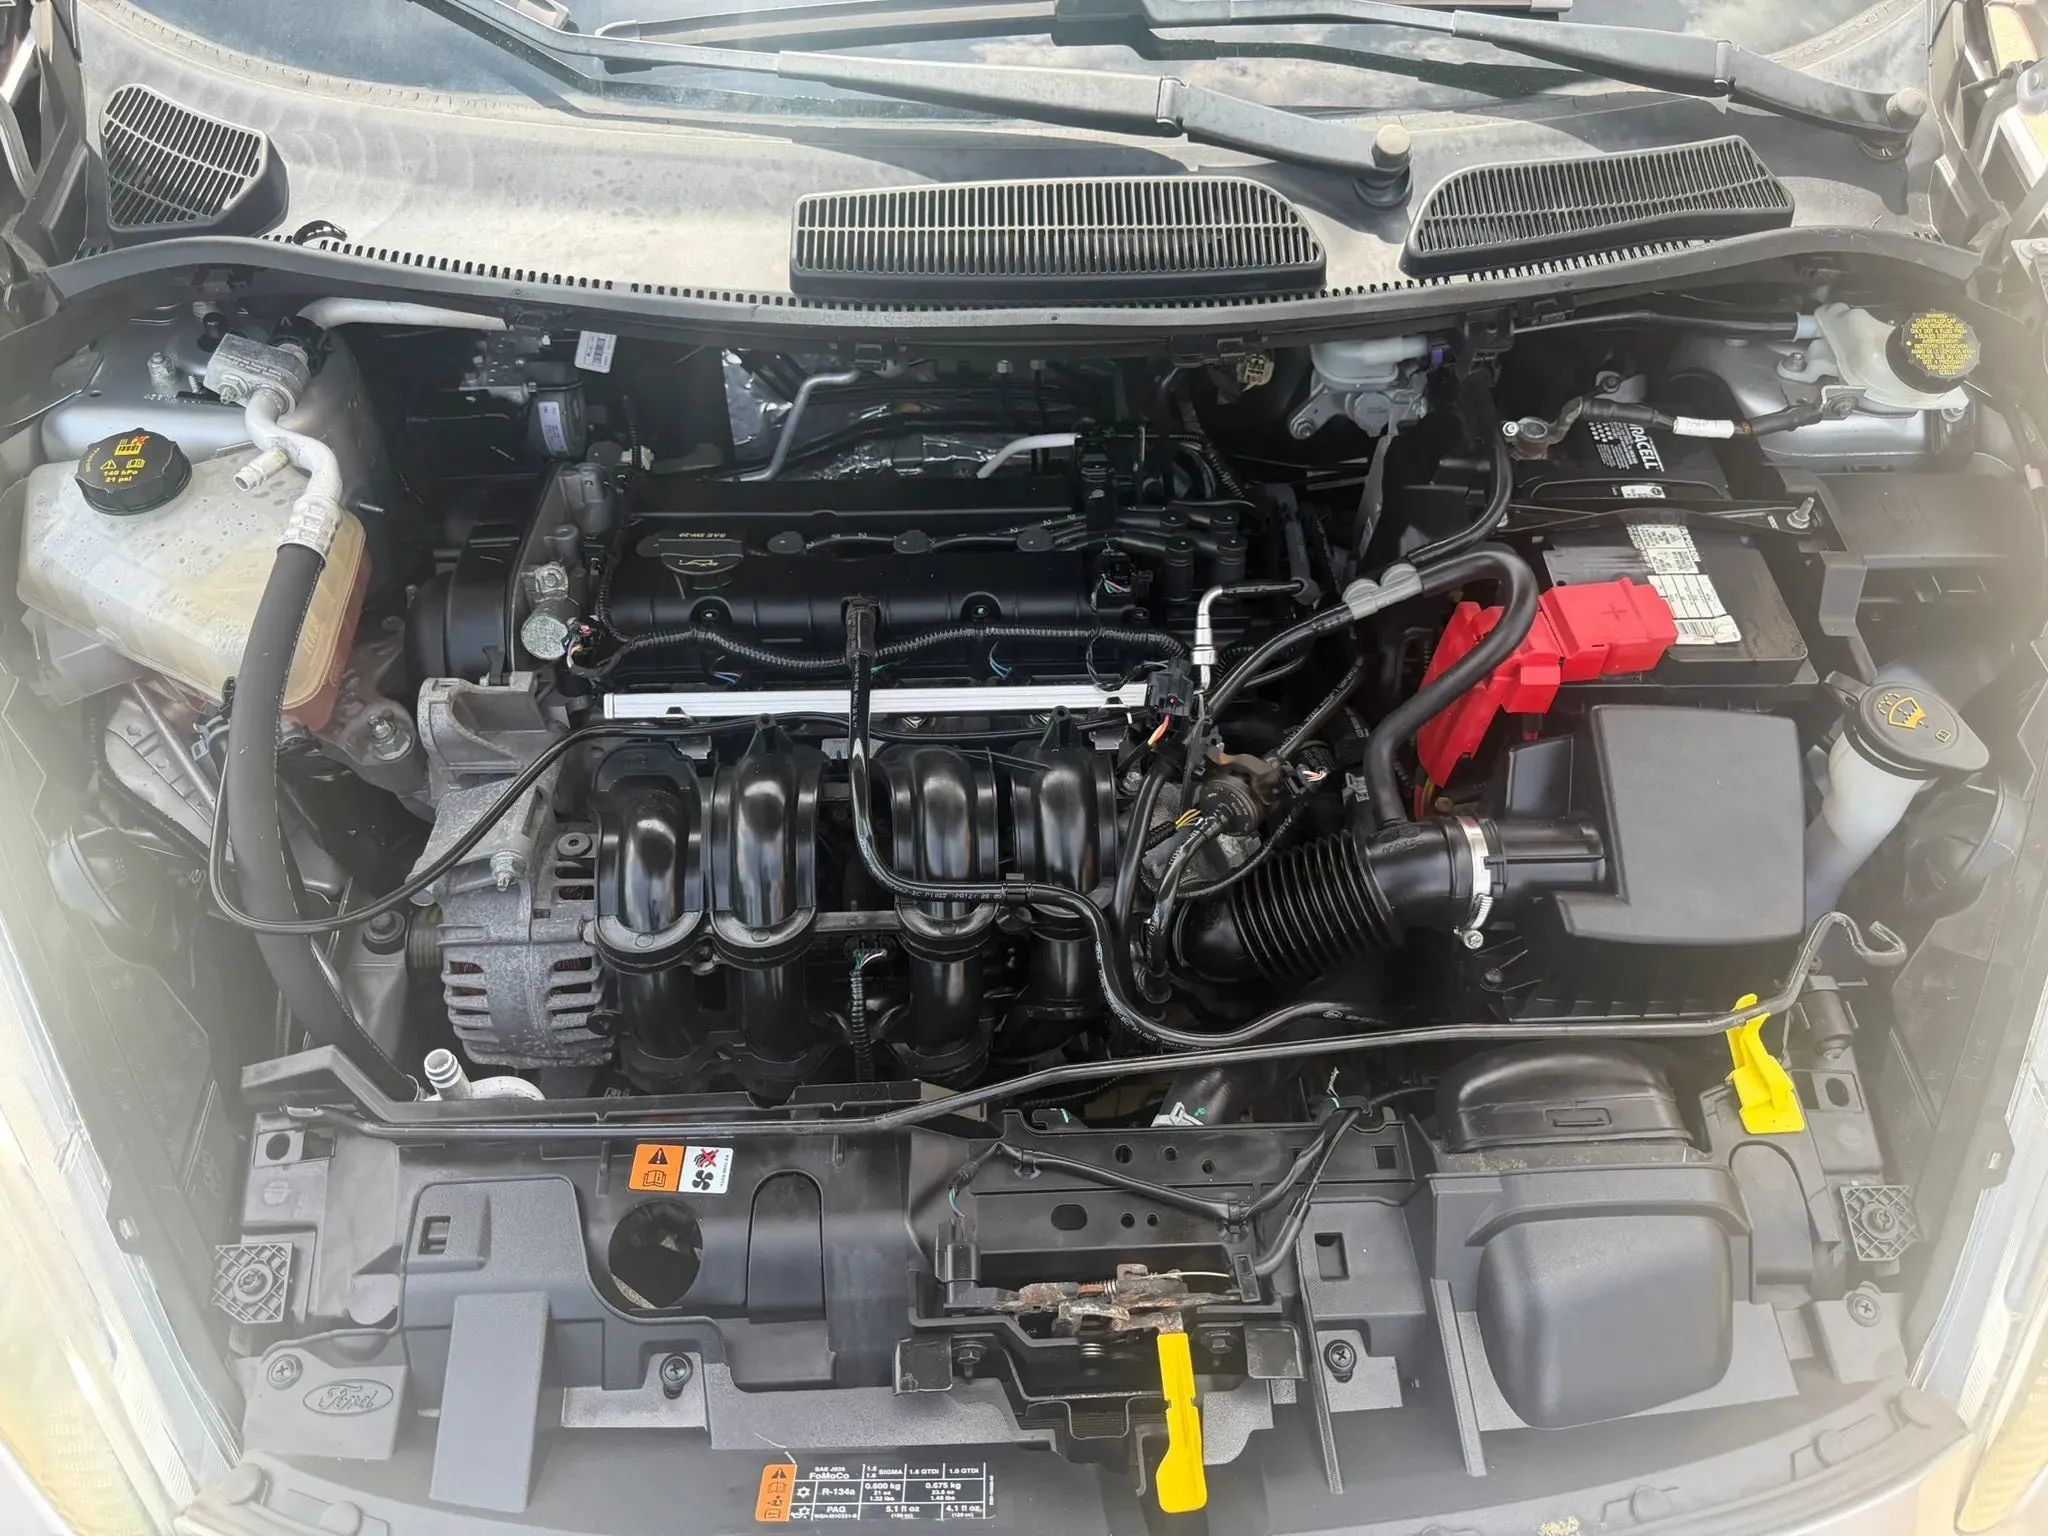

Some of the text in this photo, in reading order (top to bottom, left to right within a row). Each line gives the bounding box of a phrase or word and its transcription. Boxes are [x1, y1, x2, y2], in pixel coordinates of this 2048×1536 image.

[318, 1385, 378, 1411] Ford
[809, 1472, 850, 1480] FoMoCo
[864, 1482, 901, 1491] 0.600 kg
[950, 1482, 962, 1490] kg
[822, 1488, 856, 1496] R-134a
[886, 1505, 898, 1513] 5.1
[946, 1504, 958, 1512] 4.1
